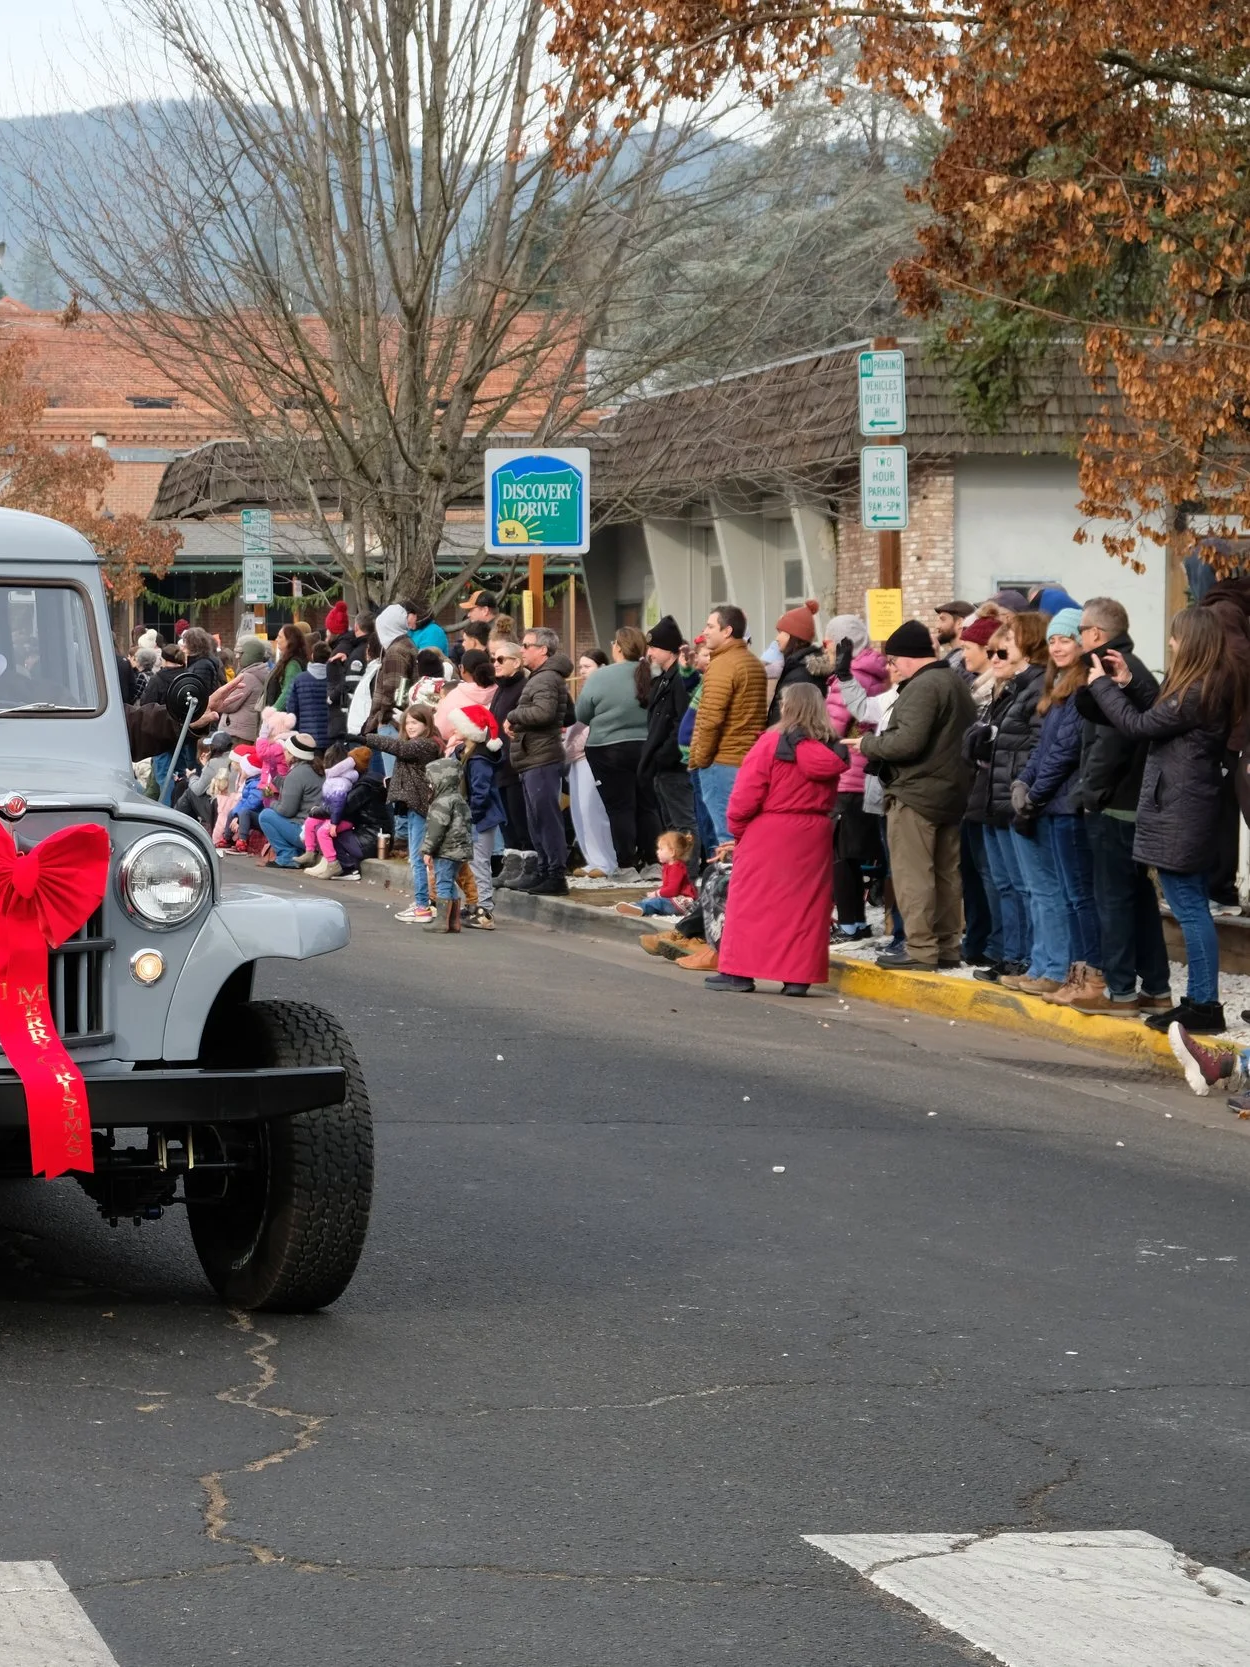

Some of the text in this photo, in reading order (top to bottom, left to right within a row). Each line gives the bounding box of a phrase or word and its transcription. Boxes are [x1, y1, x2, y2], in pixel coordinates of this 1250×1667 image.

[862, 358, 901, 374] NO PARKING
[866, 380, 897, 391] VEHICLES
[864, 394, 882, 405] OVER
[885, 394, 889, 405] 7
[874, 407, 890, 417] HIGH
[875, 456, 892, 467] TWO
[872, 471, 895, 482] HOUR
[503, 483, 573, 500] DISCOVERY
[868, 486, 901, 497] PARKING
[517, 502, 560, 517] DRIVE
[17, 983, 51, 1050] MERRY
